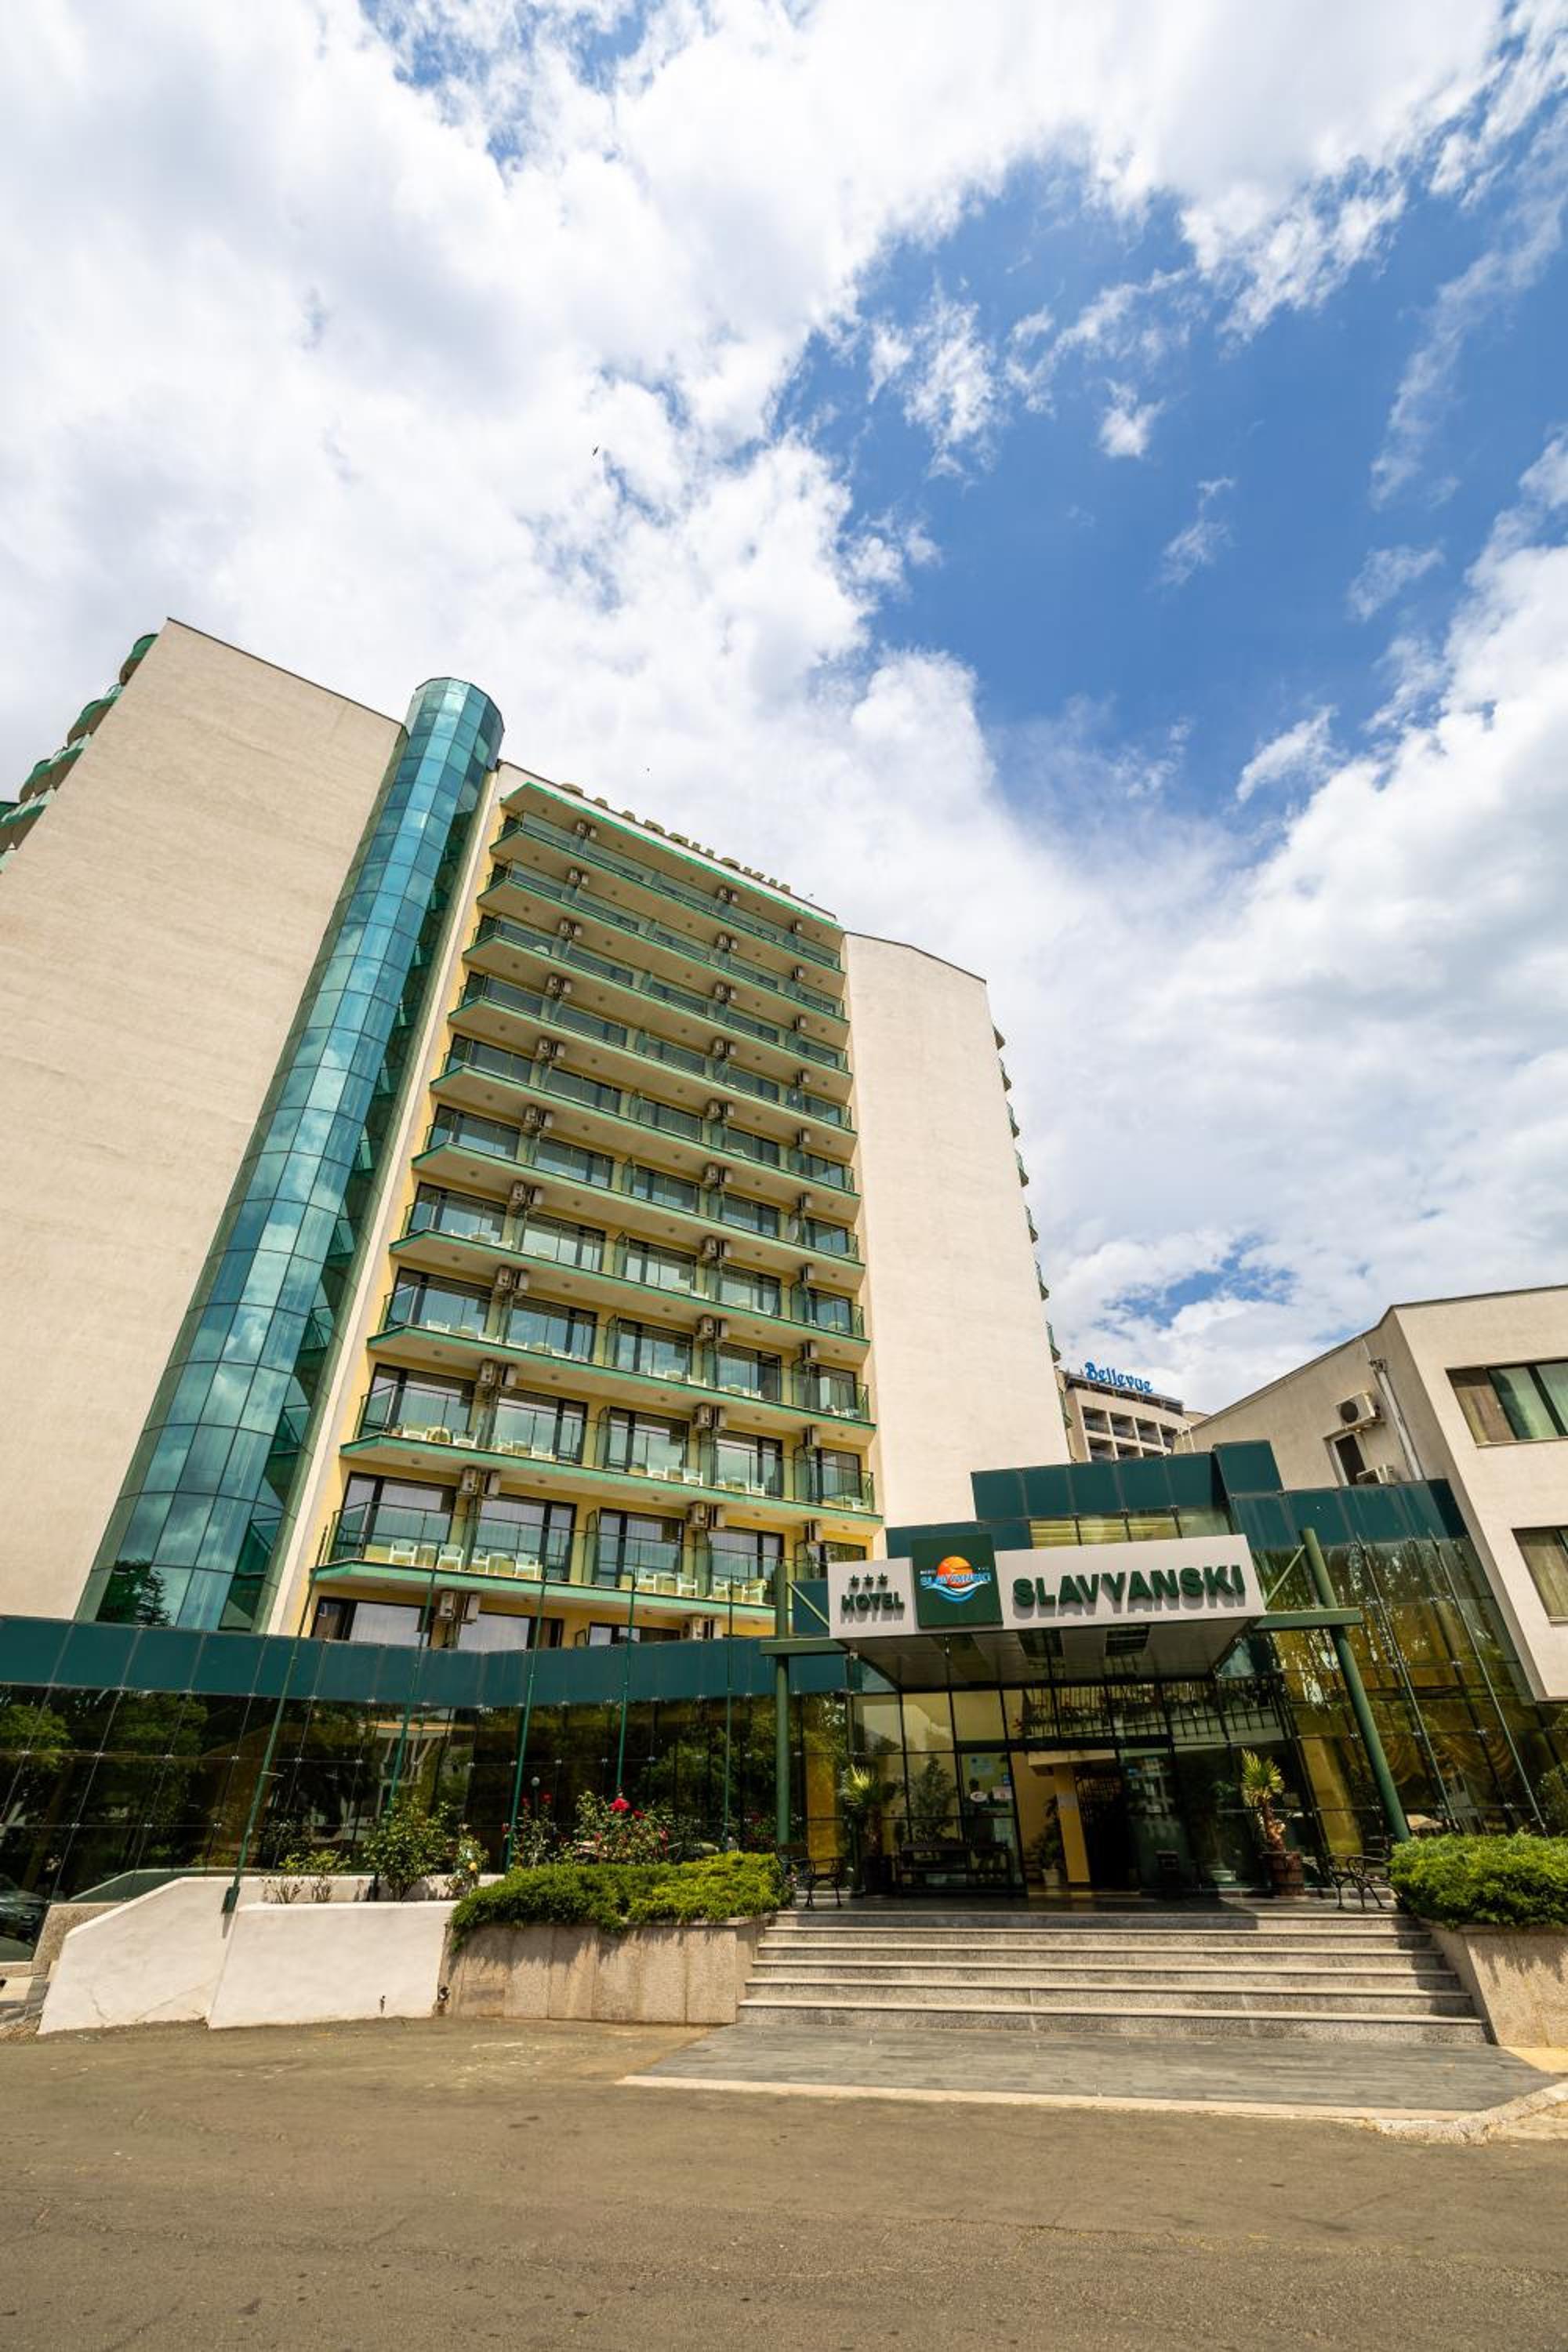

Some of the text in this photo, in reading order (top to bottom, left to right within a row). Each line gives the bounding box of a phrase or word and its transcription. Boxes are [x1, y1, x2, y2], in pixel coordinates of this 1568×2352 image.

[1085, 1362, 1153, 1392] Bellevue
[1013, 1565, 1246, 1607] SLAVYANSKI
[841, 1592, 905, 1612] HOTEL
